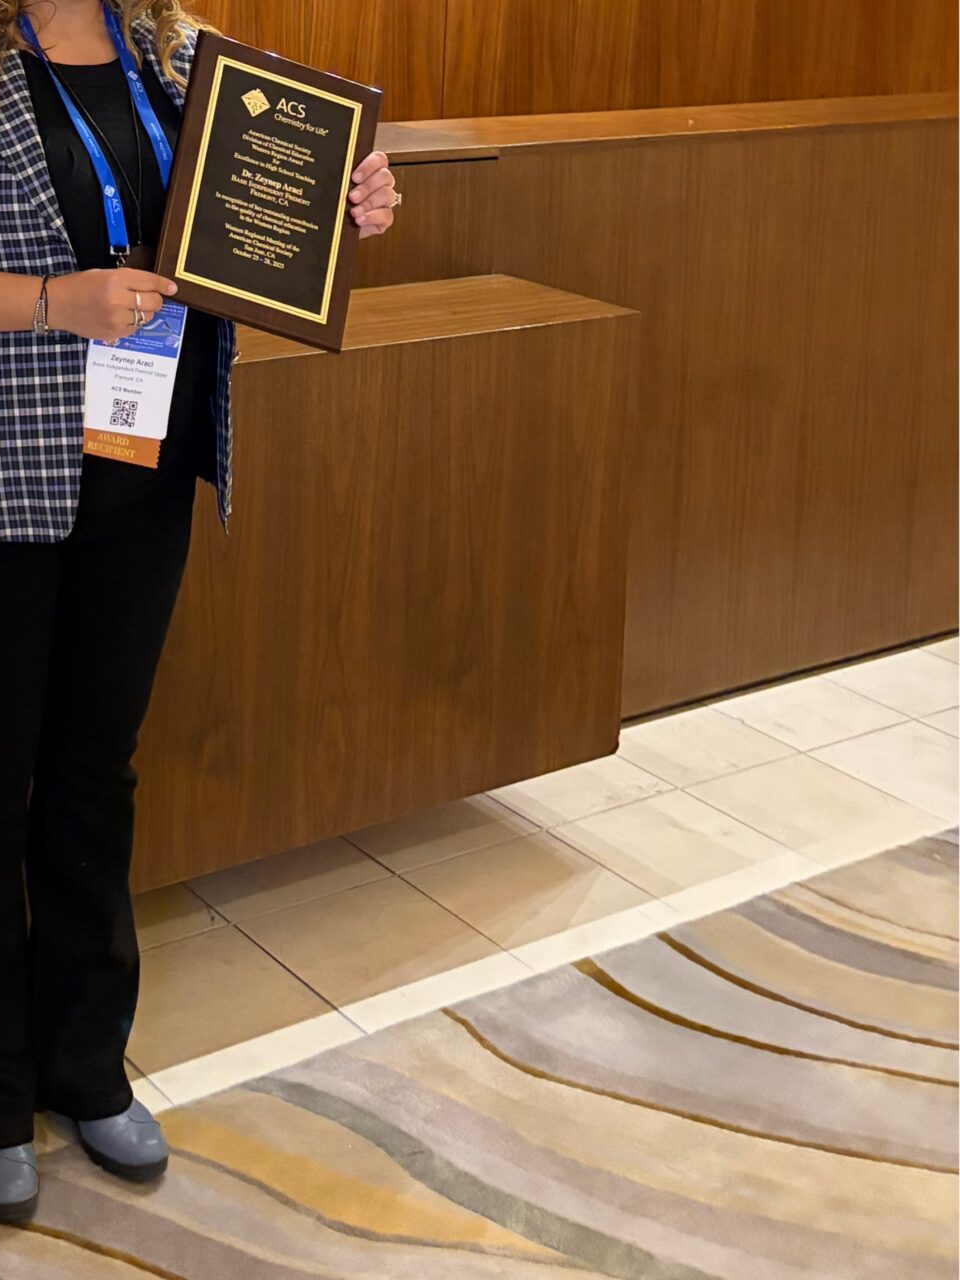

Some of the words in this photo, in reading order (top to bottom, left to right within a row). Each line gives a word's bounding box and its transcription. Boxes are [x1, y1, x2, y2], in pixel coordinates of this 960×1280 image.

[276, 98, 306, 118] ACS
[274, 113, 306, 130] Chemistry
[305, 123, 315, 132] for
[242, 134, 262, 144] Division
[269, 143, 291, 154] Chemical
[291, 150, 314, 162] Education
[248, 130, 271, 141] American
[271, 137, 293, 148] Chemical
[294, 144, 311, 155] Society
[234, 152, 259, 165] Excellence
[265, 163, 277, 171] High
[278, 167, 294, 177] School
[295, 173, 315, 185] Teaching
[288, 157, 303, 166] Award
[242, 169, 253, 179] Dr.
[255, 173, 282, 189] Zeynep
[282, 183, 303, 195] Araci
[111, 197, 121, 213] ACS
[278, 198, 289, 206] CA
[229, 232, 252, 243] American
[252, 240, 275, 251] Chemical
[275, 247, 293, 258] Society
[233, 248, 252, 258] October
[110, 354, 135, 365] Zeynep
[123, 388, 142, 396] Member
[97, 432, 130, 445] AWARD
[87, 440, 137, 459] RECIPIENT
